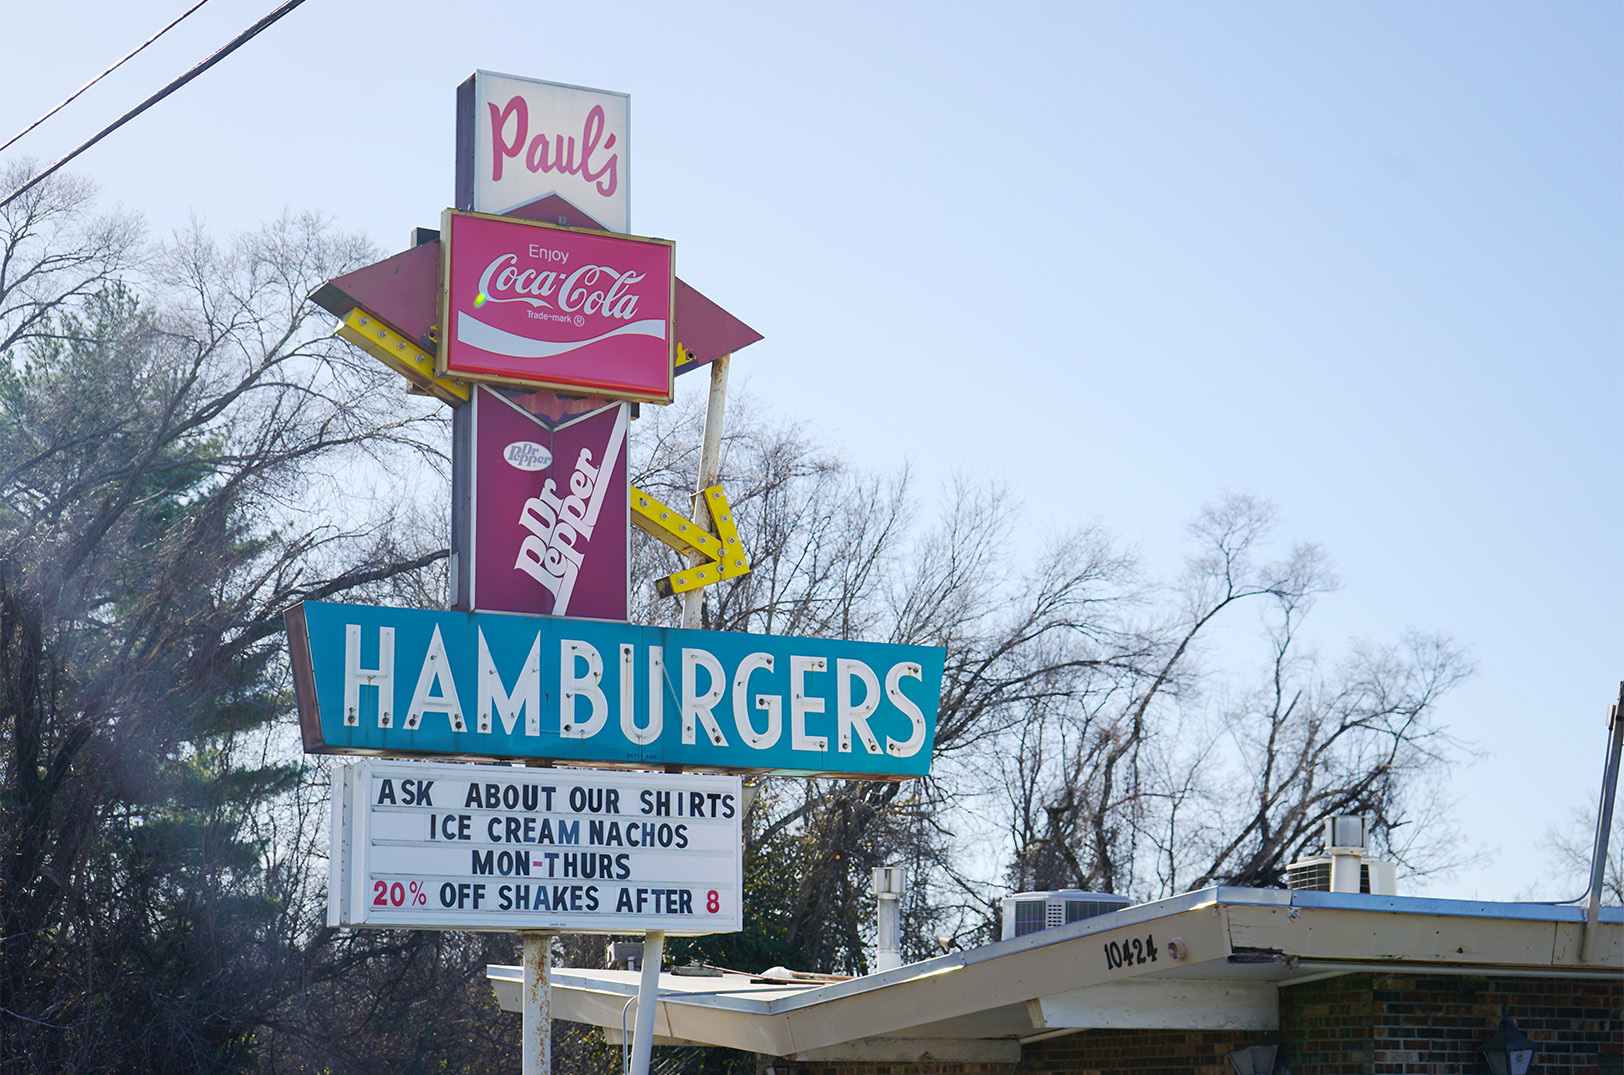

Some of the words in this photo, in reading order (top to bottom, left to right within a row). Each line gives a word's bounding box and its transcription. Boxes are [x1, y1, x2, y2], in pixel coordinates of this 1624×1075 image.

[487, 95, 618, 197] Paul's
[529, 243, 569, 264] Enjoy
[478, 253, 647, 320] Coca-Cola
[527, 309, 572, 323] Trade-mark
[508, 445, 552, 467] Pepper
[521, 443, 540, 456] Dr
[514, 447, 600, 600] Pepper
[518, 478, 565, 547] Dr
[343, 622, 927, 757] HAMBURGERS
[377, 779, 435, 806] ASK
[464, 782, 557, 811] ABOUT
[569, 786, 620, 814] OUR
[640, 789, 736, 819] SHIRTS
[430, 814, 472, 840] ICE
[487, 816, 580, 844] CREAM
[589, 820, 689, 849] NACHOS
[472, 850, 631, 880] MON-THURS
[373, 880, 427, 907] 20%
[439, 882, 486, 908] OFF
[498, 884, 600, 911] SHAKES
[615, 887, 693, 914] AFTER
[706, 889, 720, 914] 8
[1104, 934, 1158, 970] 10424
